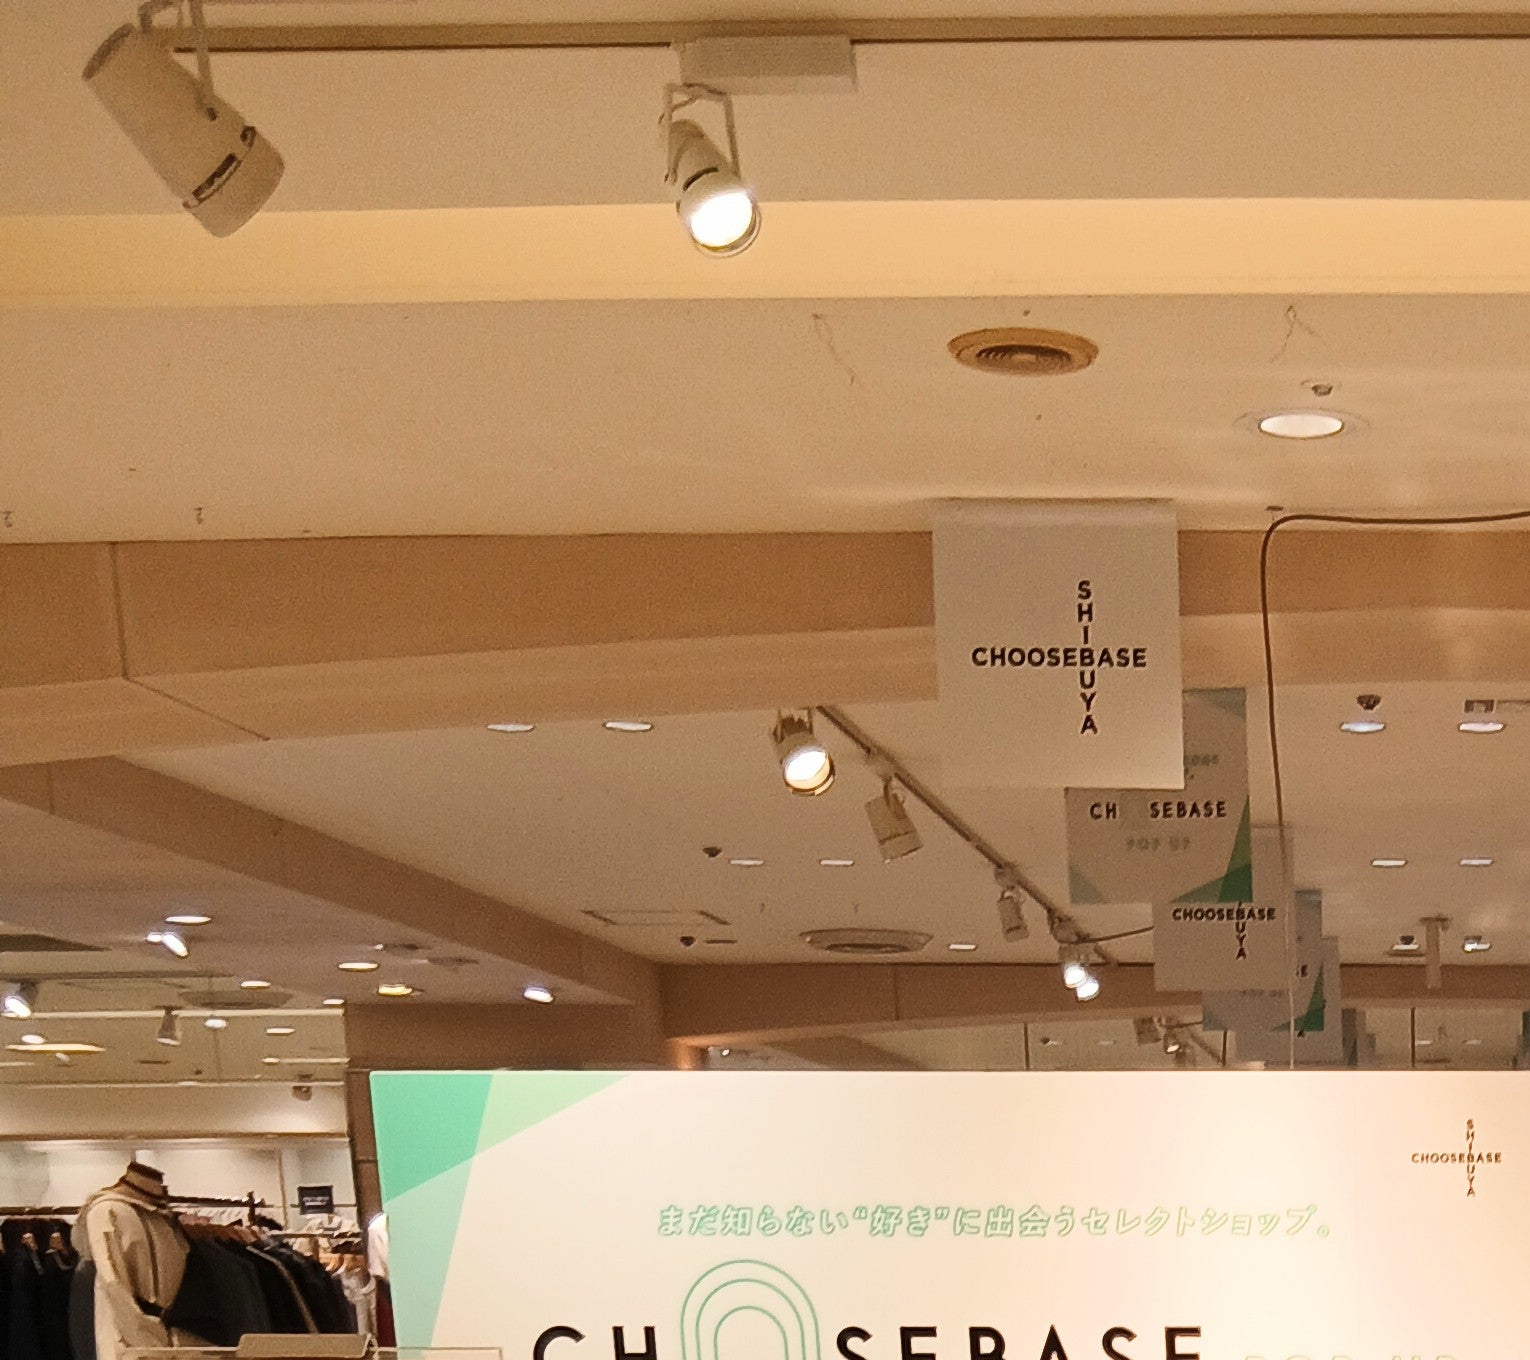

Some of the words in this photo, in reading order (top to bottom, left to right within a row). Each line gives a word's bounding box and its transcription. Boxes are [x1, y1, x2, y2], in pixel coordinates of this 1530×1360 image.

[971, 647, 1147, 668] CHOOSEBASE
[1077, 580, 1098, 734] SHIBUYA
[1171, 907, 1276, 922] CHOOSEBASE
[1410, 1152, 1502, 1164] CHOOSEBASE
